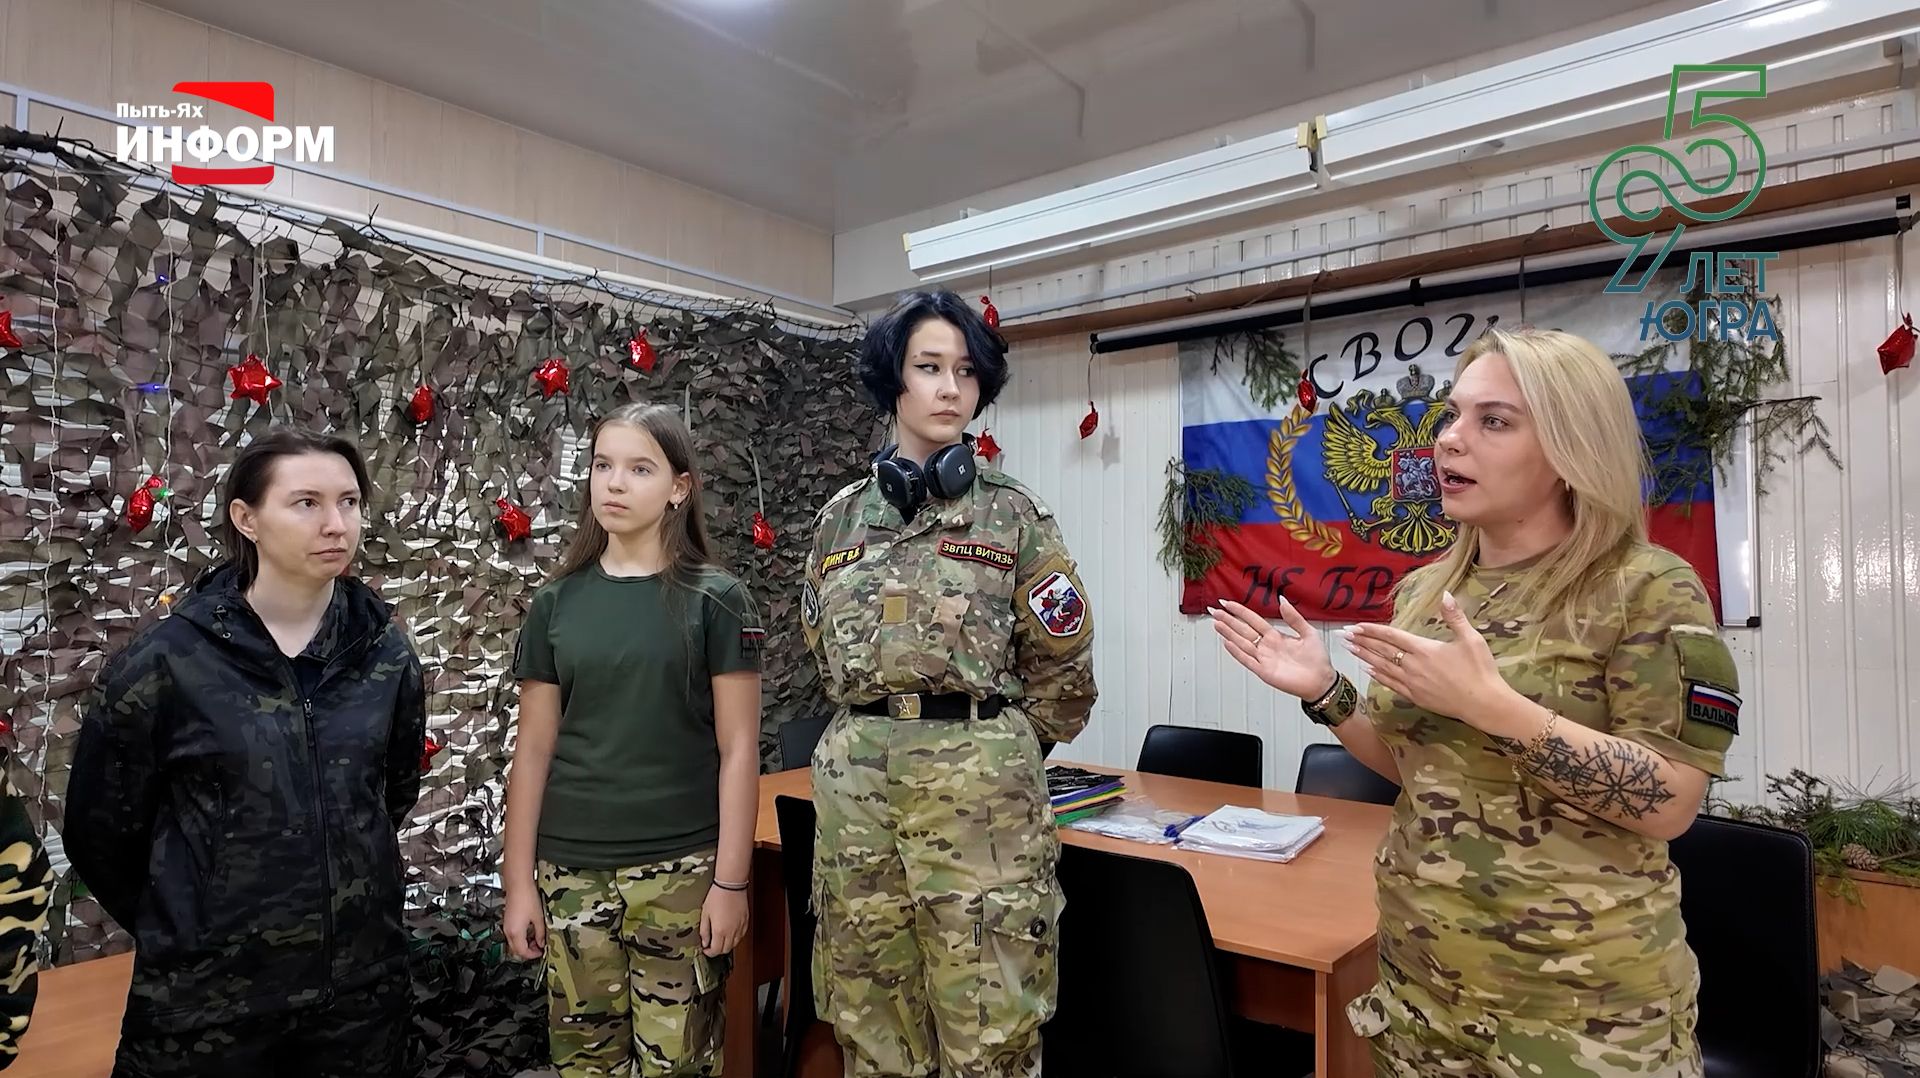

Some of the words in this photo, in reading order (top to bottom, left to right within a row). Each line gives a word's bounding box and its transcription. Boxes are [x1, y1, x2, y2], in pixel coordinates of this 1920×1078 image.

[943, 543, 972, 556] ЗВПЦ
[975, 547, 1014, 565] ВИТЯЗЬ
[1319, 565, 1419, 611] БР
